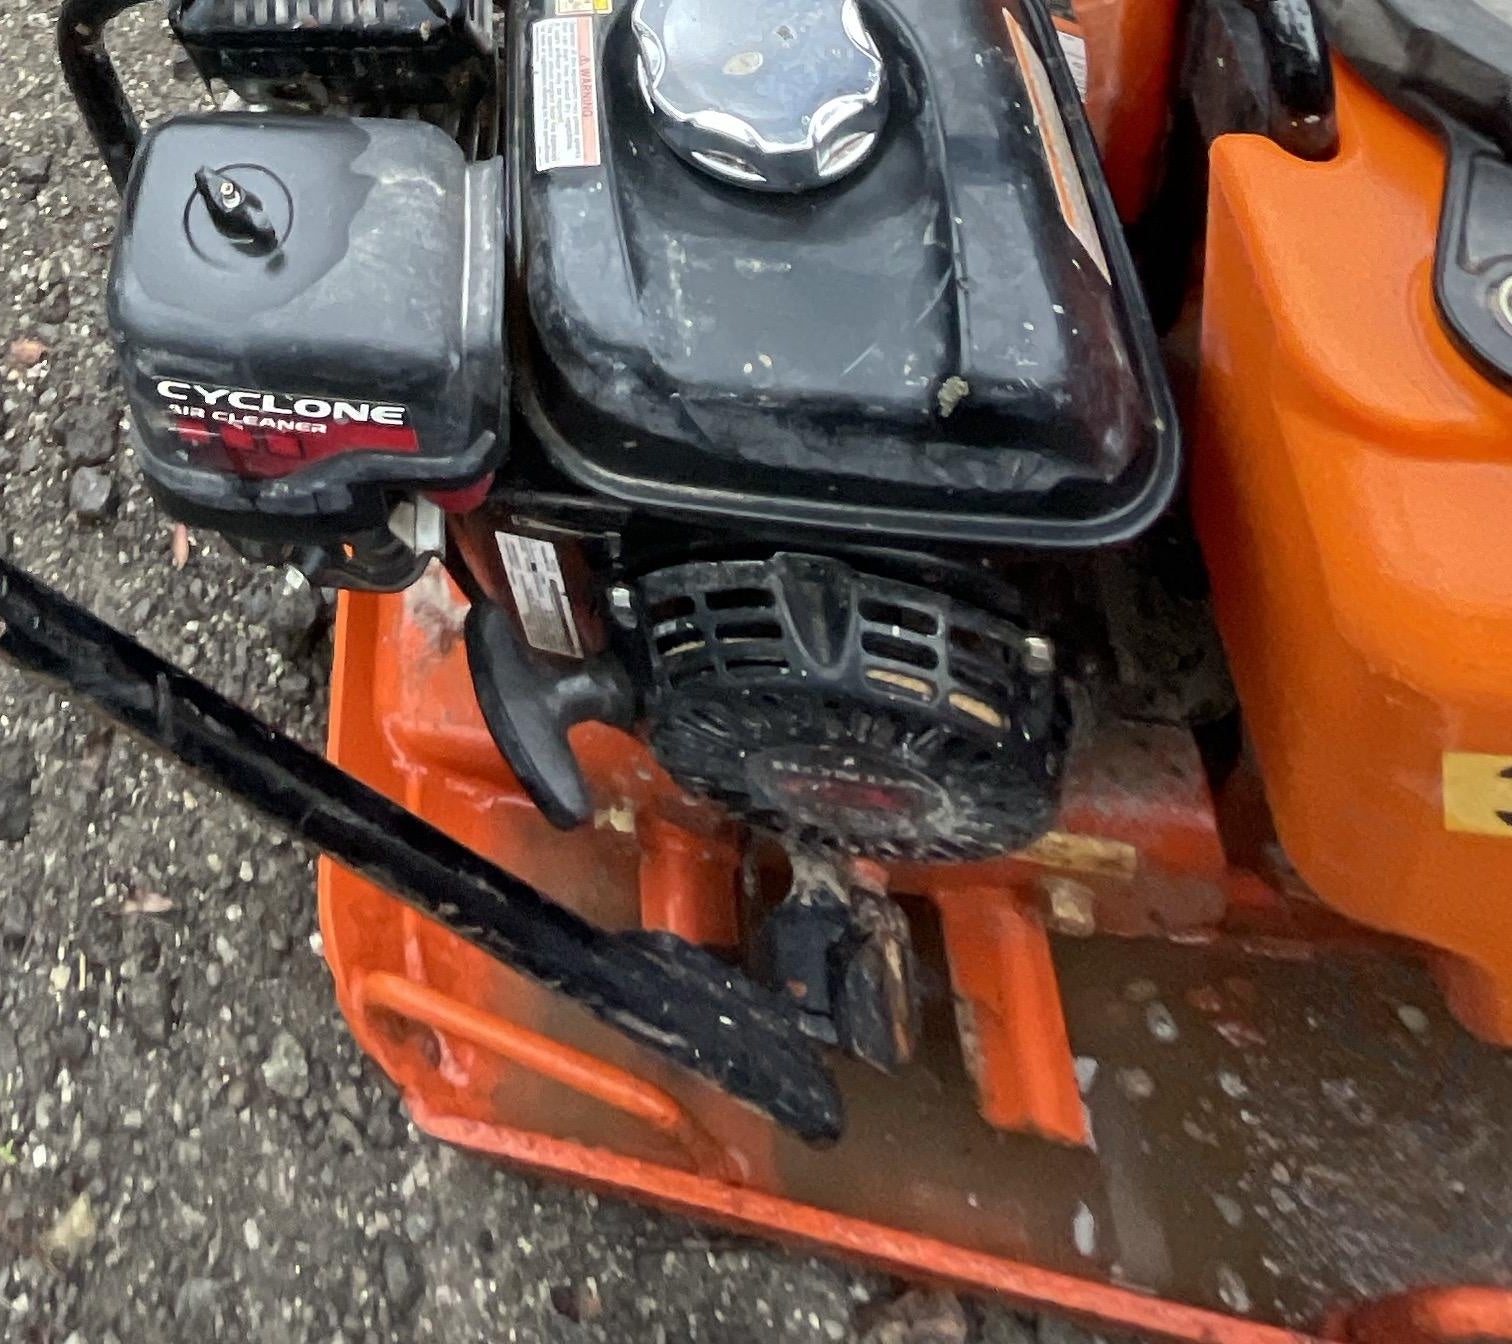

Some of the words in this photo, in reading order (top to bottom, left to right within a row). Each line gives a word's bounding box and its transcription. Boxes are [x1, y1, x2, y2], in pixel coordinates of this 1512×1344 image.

[580, 68, 593, 118] WARNING
[156, 379, 406, 426] CYCLONE
[168, 403, 206, 419] AIR
[211, 411, 328, 434] CLEANER
